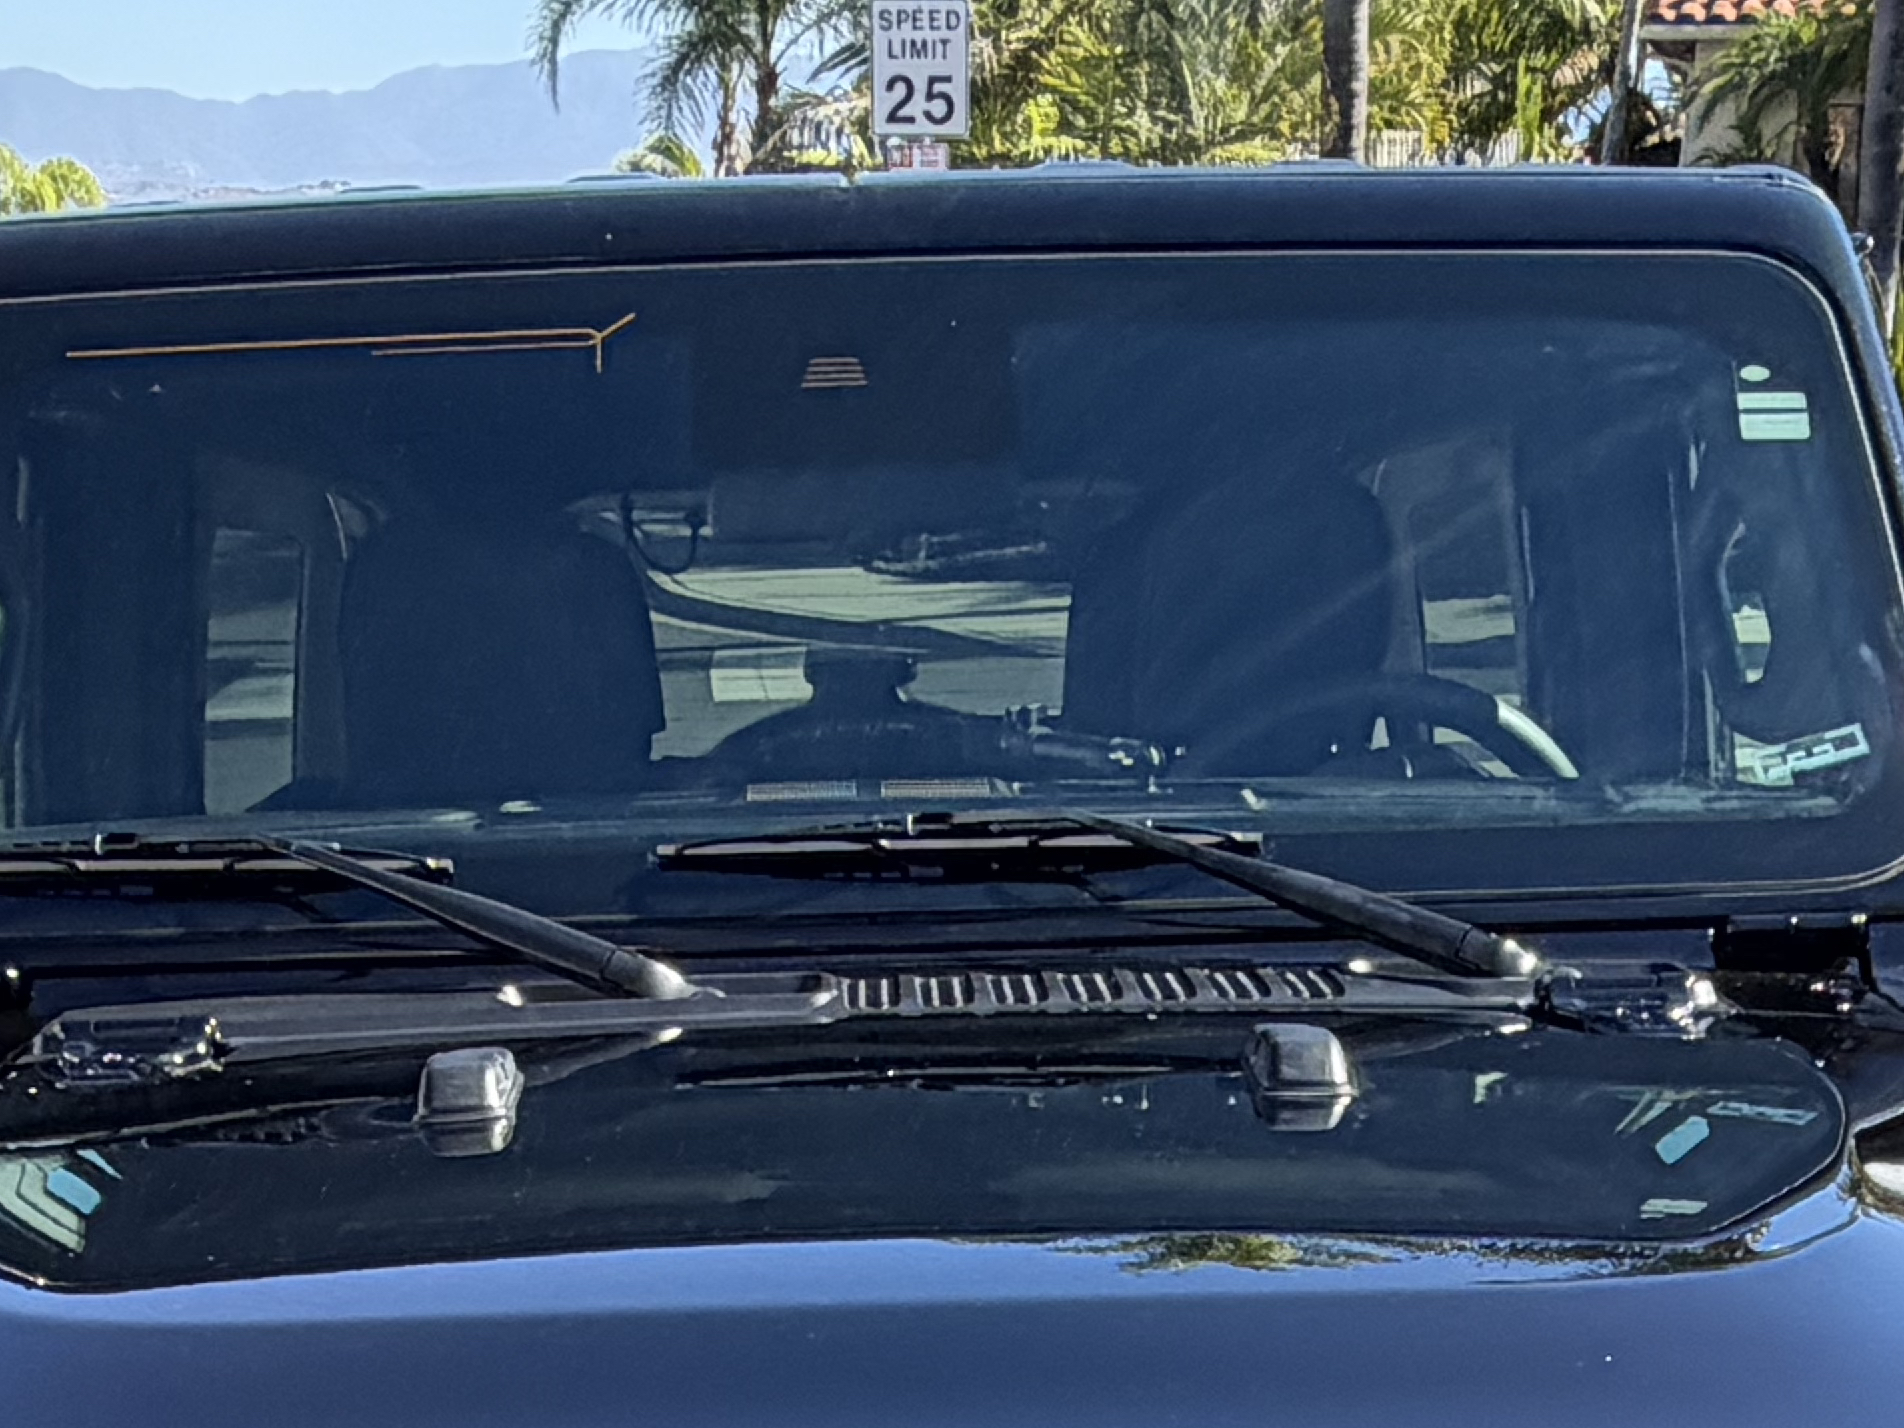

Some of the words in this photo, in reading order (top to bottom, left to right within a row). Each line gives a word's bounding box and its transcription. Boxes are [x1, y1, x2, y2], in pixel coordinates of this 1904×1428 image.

[878, 8, 961, 31] SPEED
[887, 38, 952, 60] LIMIT
[884, 74, 955, 126] 25
